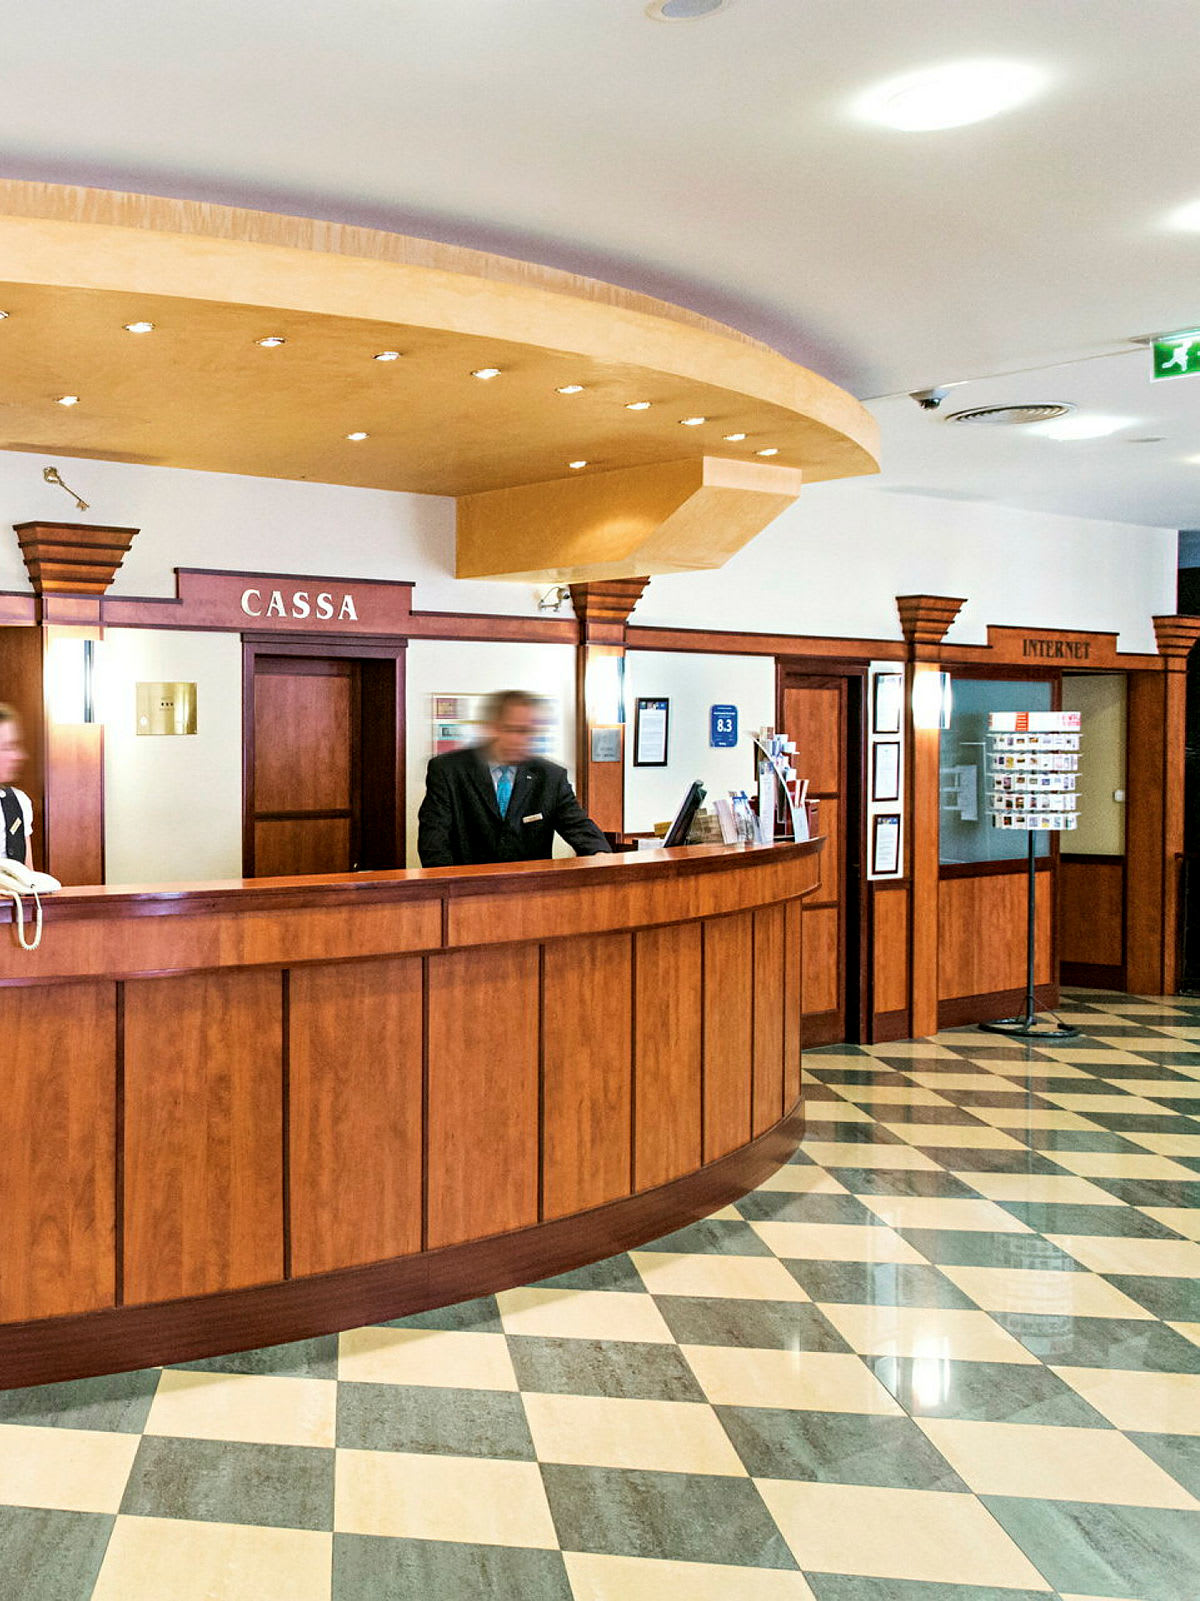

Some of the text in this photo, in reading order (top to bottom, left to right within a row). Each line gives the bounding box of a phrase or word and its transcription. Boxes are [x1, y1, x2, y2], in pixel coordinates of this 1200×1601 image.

[240, 588, 358, 621] CASSA
[1022, 639, 1091, 659] INTERNET
[717, 718, 732, 732] 8.3
